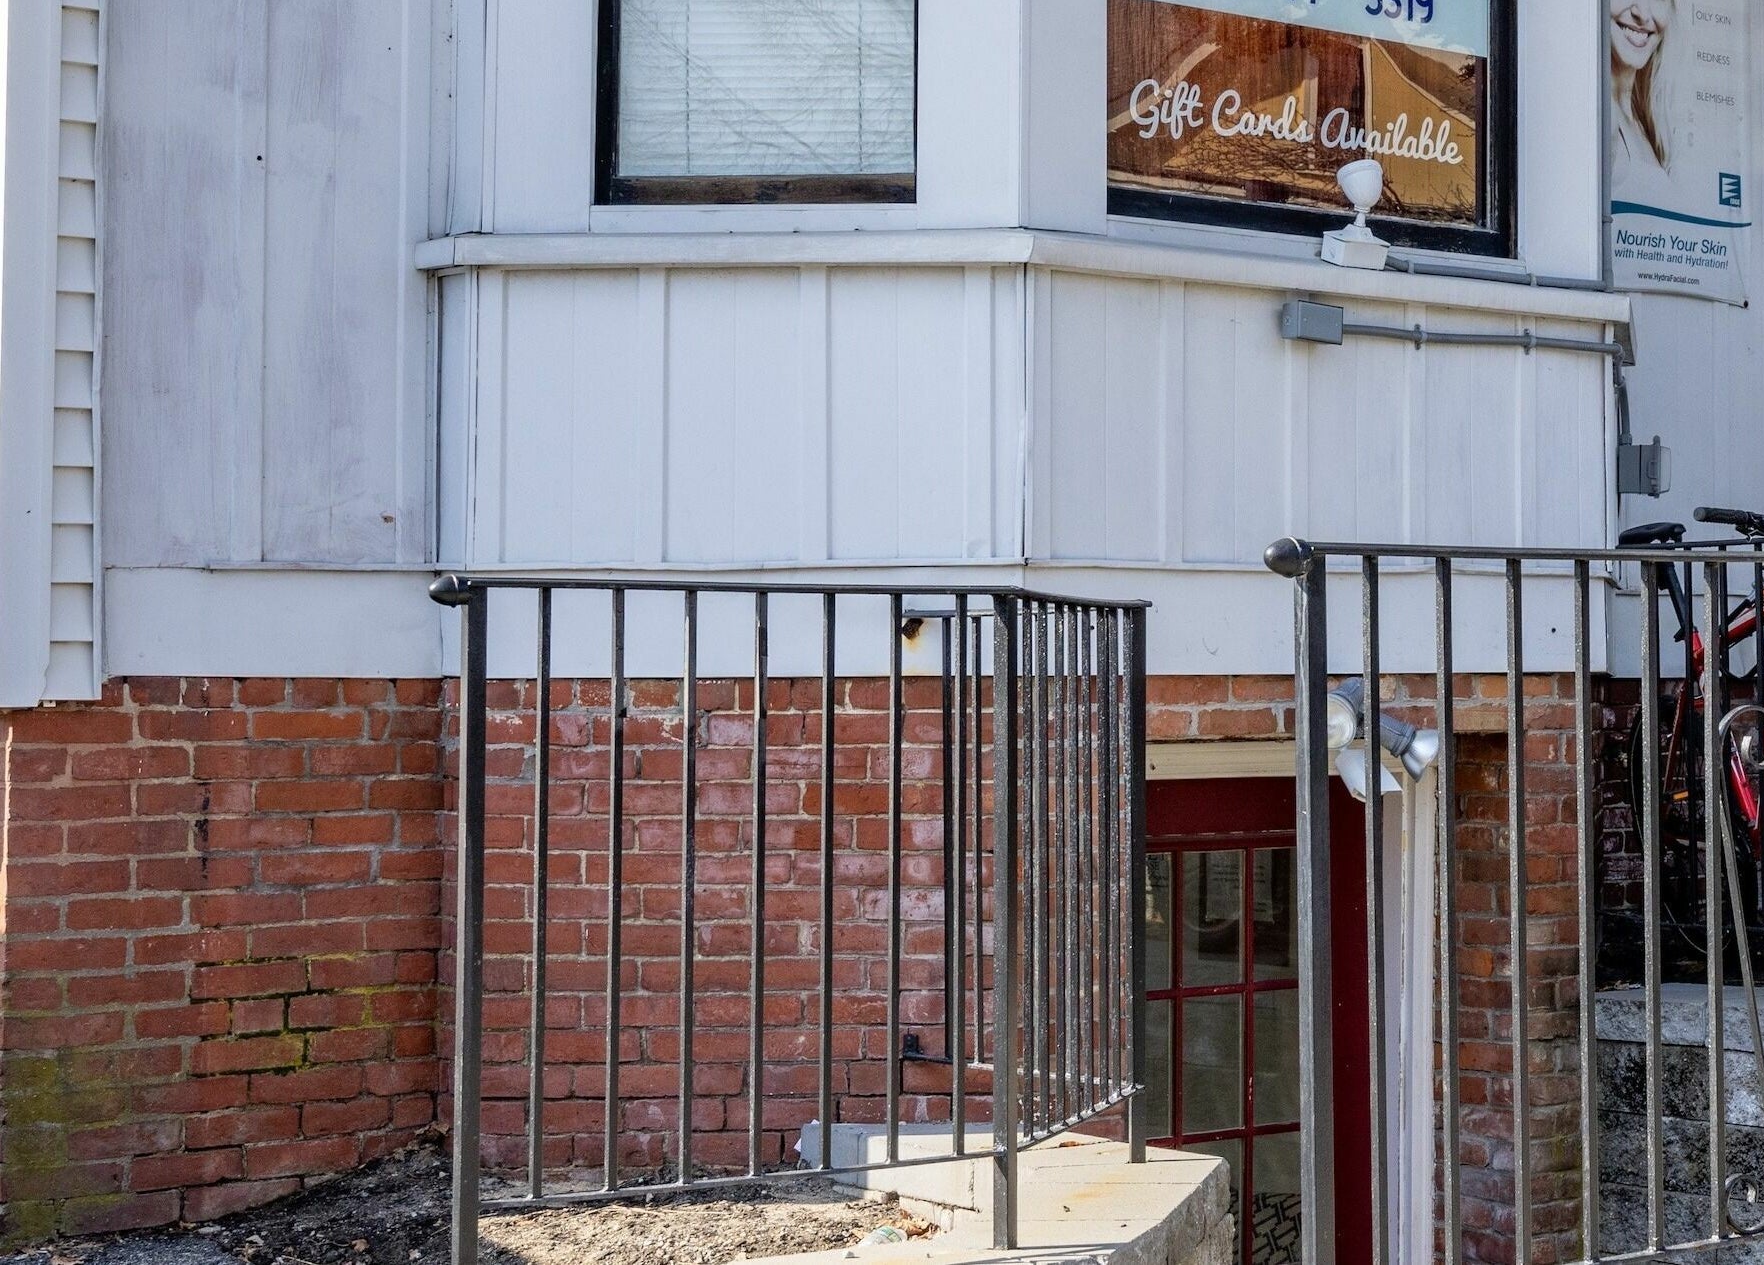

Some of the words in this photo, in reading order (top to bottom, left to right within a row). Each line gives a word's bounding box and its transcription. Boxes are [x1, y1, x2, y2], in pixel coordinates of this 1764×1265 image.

[1695, 10, 1713, 22] OILY
[1714, 13, 1731, 25] SKIN
[1696, 50, 1731, 66] REDNESS
[1696, 91, 1735, 107] BLEMISHES
[1129, 78, 1204, 140] Gift
[1211, 89, 1313, 144] Cards
[1320, 107, 1464, 165] Available
[1616, 229, 1666, 249] Nourish
[1669, 235, 1699, 253] Your
[1701, 239, 1727, 256] Skin
[1614, 247, 1634, 259] with
[1636, 249, 1665, 262] Health
[1666, 253, 1683, 264] and
[1685, 255, 1729, 271] Hydration!
[1637, 272, 1700, 286] www.HydraFacial.com
